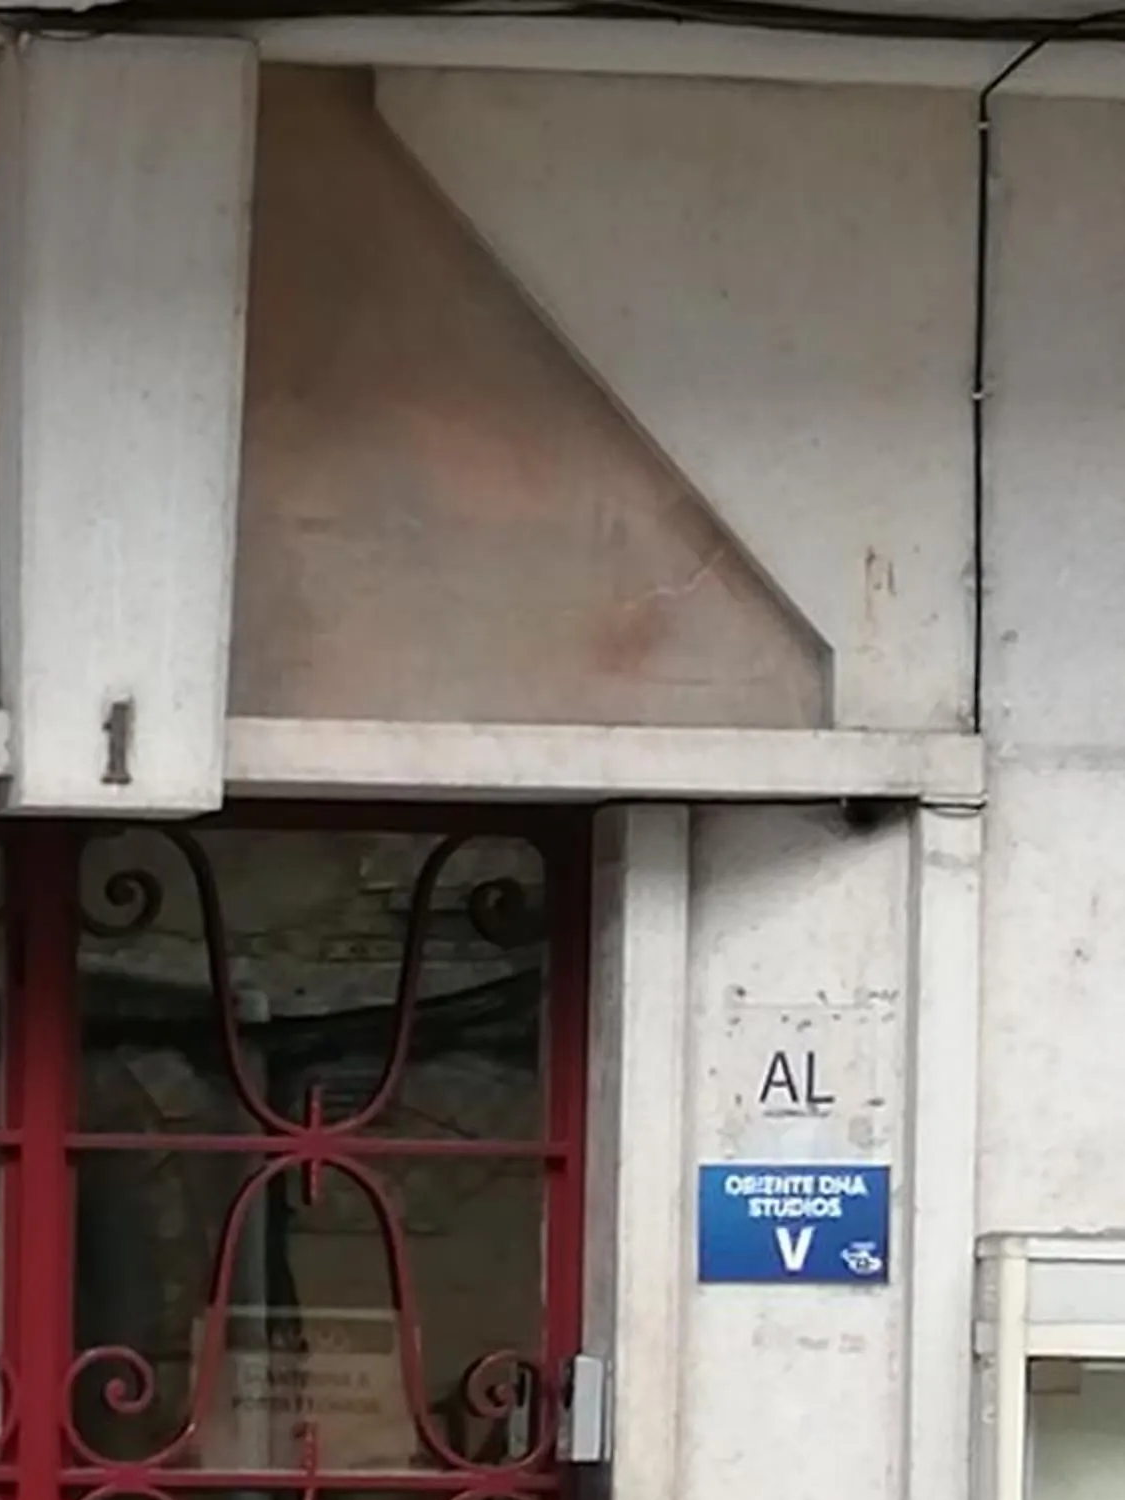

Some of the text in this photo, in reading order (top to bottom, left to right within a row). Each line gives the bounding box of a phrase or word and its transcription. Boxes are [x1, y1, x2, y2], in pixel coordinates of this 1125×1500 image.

[101, 702, 133, 785] 1
[760, 1050, 835, 1104] AL
[748, 1197, 843, 1217] STUDIOS
[776, 1226, 815, 1271] V
